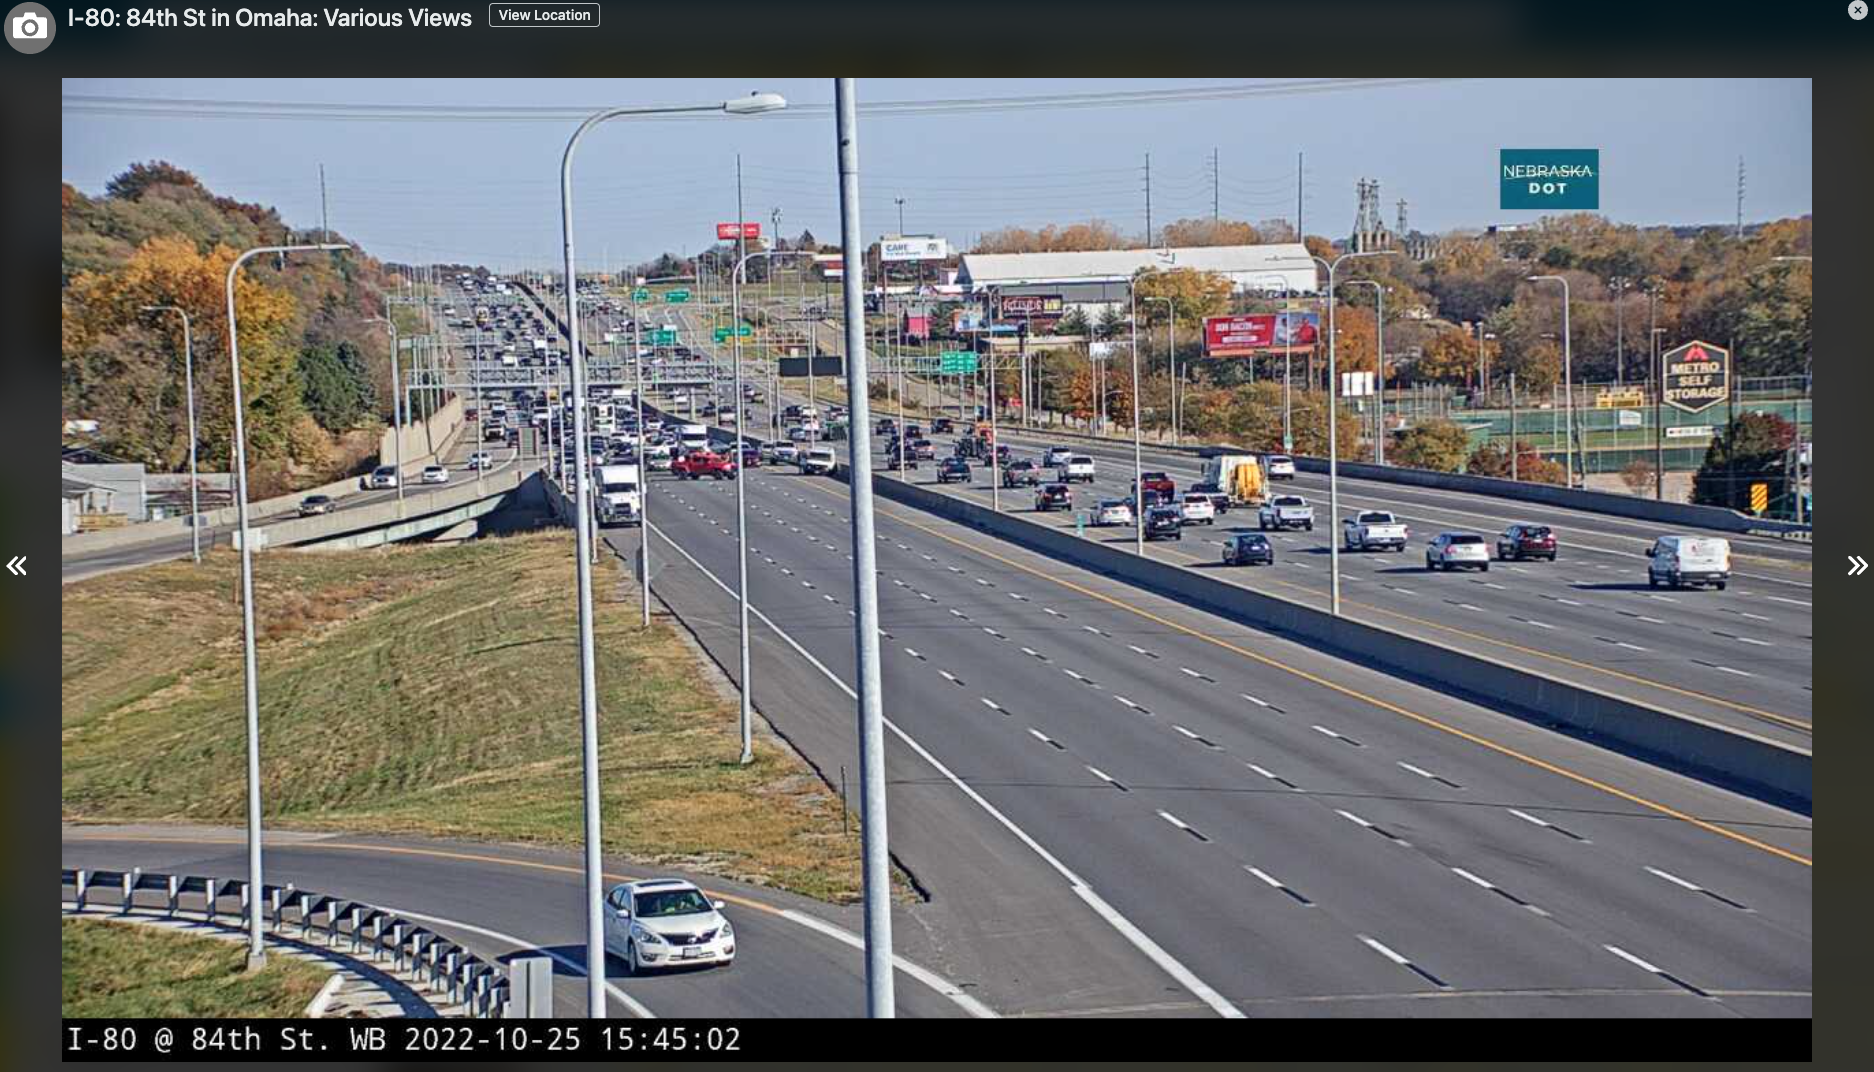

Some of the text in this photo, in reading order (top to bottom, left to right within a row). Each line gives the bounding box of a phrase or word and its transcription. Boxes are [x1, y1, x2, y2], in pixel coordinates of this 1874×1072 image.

[1671, 361, 1720, 374] METRO
[1679, 375, 1713, 387] SELF
[1666, 387, 1726, 400] STORAGE
